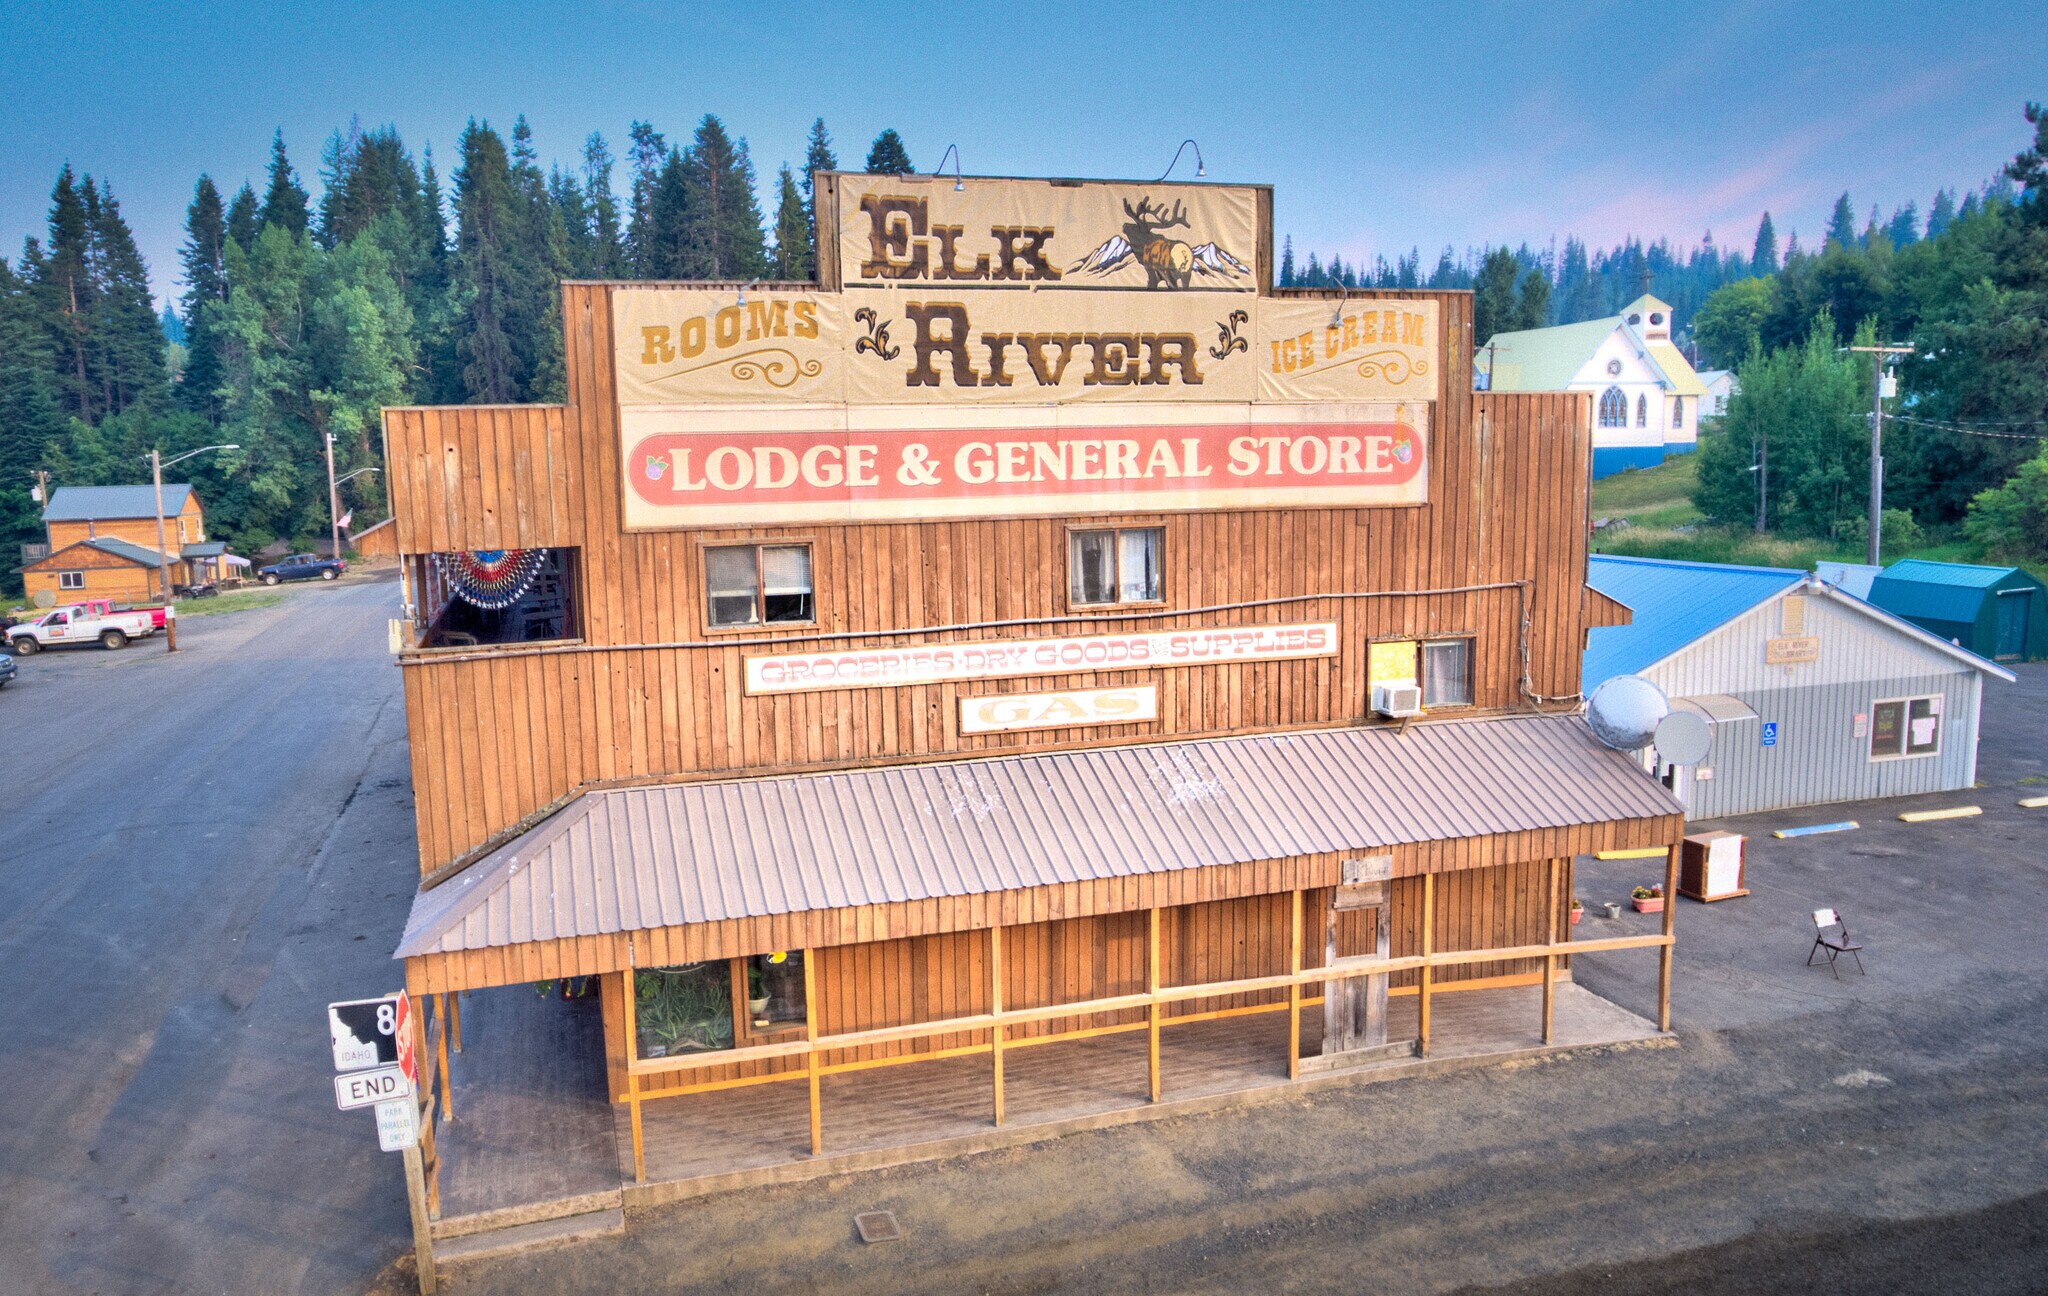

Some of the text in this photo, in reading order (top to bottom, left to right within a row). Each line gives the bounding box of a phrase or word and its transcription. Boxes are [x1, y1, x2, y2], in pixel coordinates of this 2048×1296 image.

[860, 194, 1063, 280] ELK
[641, 300, 819, 364] ROOMS
[905, 301, 1205, 387] RIVER
[1270, 310, 1425, 373] ICE CREAM
[669, 434, 1393, 492] LODGE & GENERAL STORE
[1034, 638, 1150, 667] GOODS
[1170, 628, 1326, 657] SUPPLIES
[978, 691, 1141, 725] GAS
[377, 1004, 396, 1035] 8
[341, 1049, 371, 1062] IDAHO
[351, 1076, 396, 1099] END
